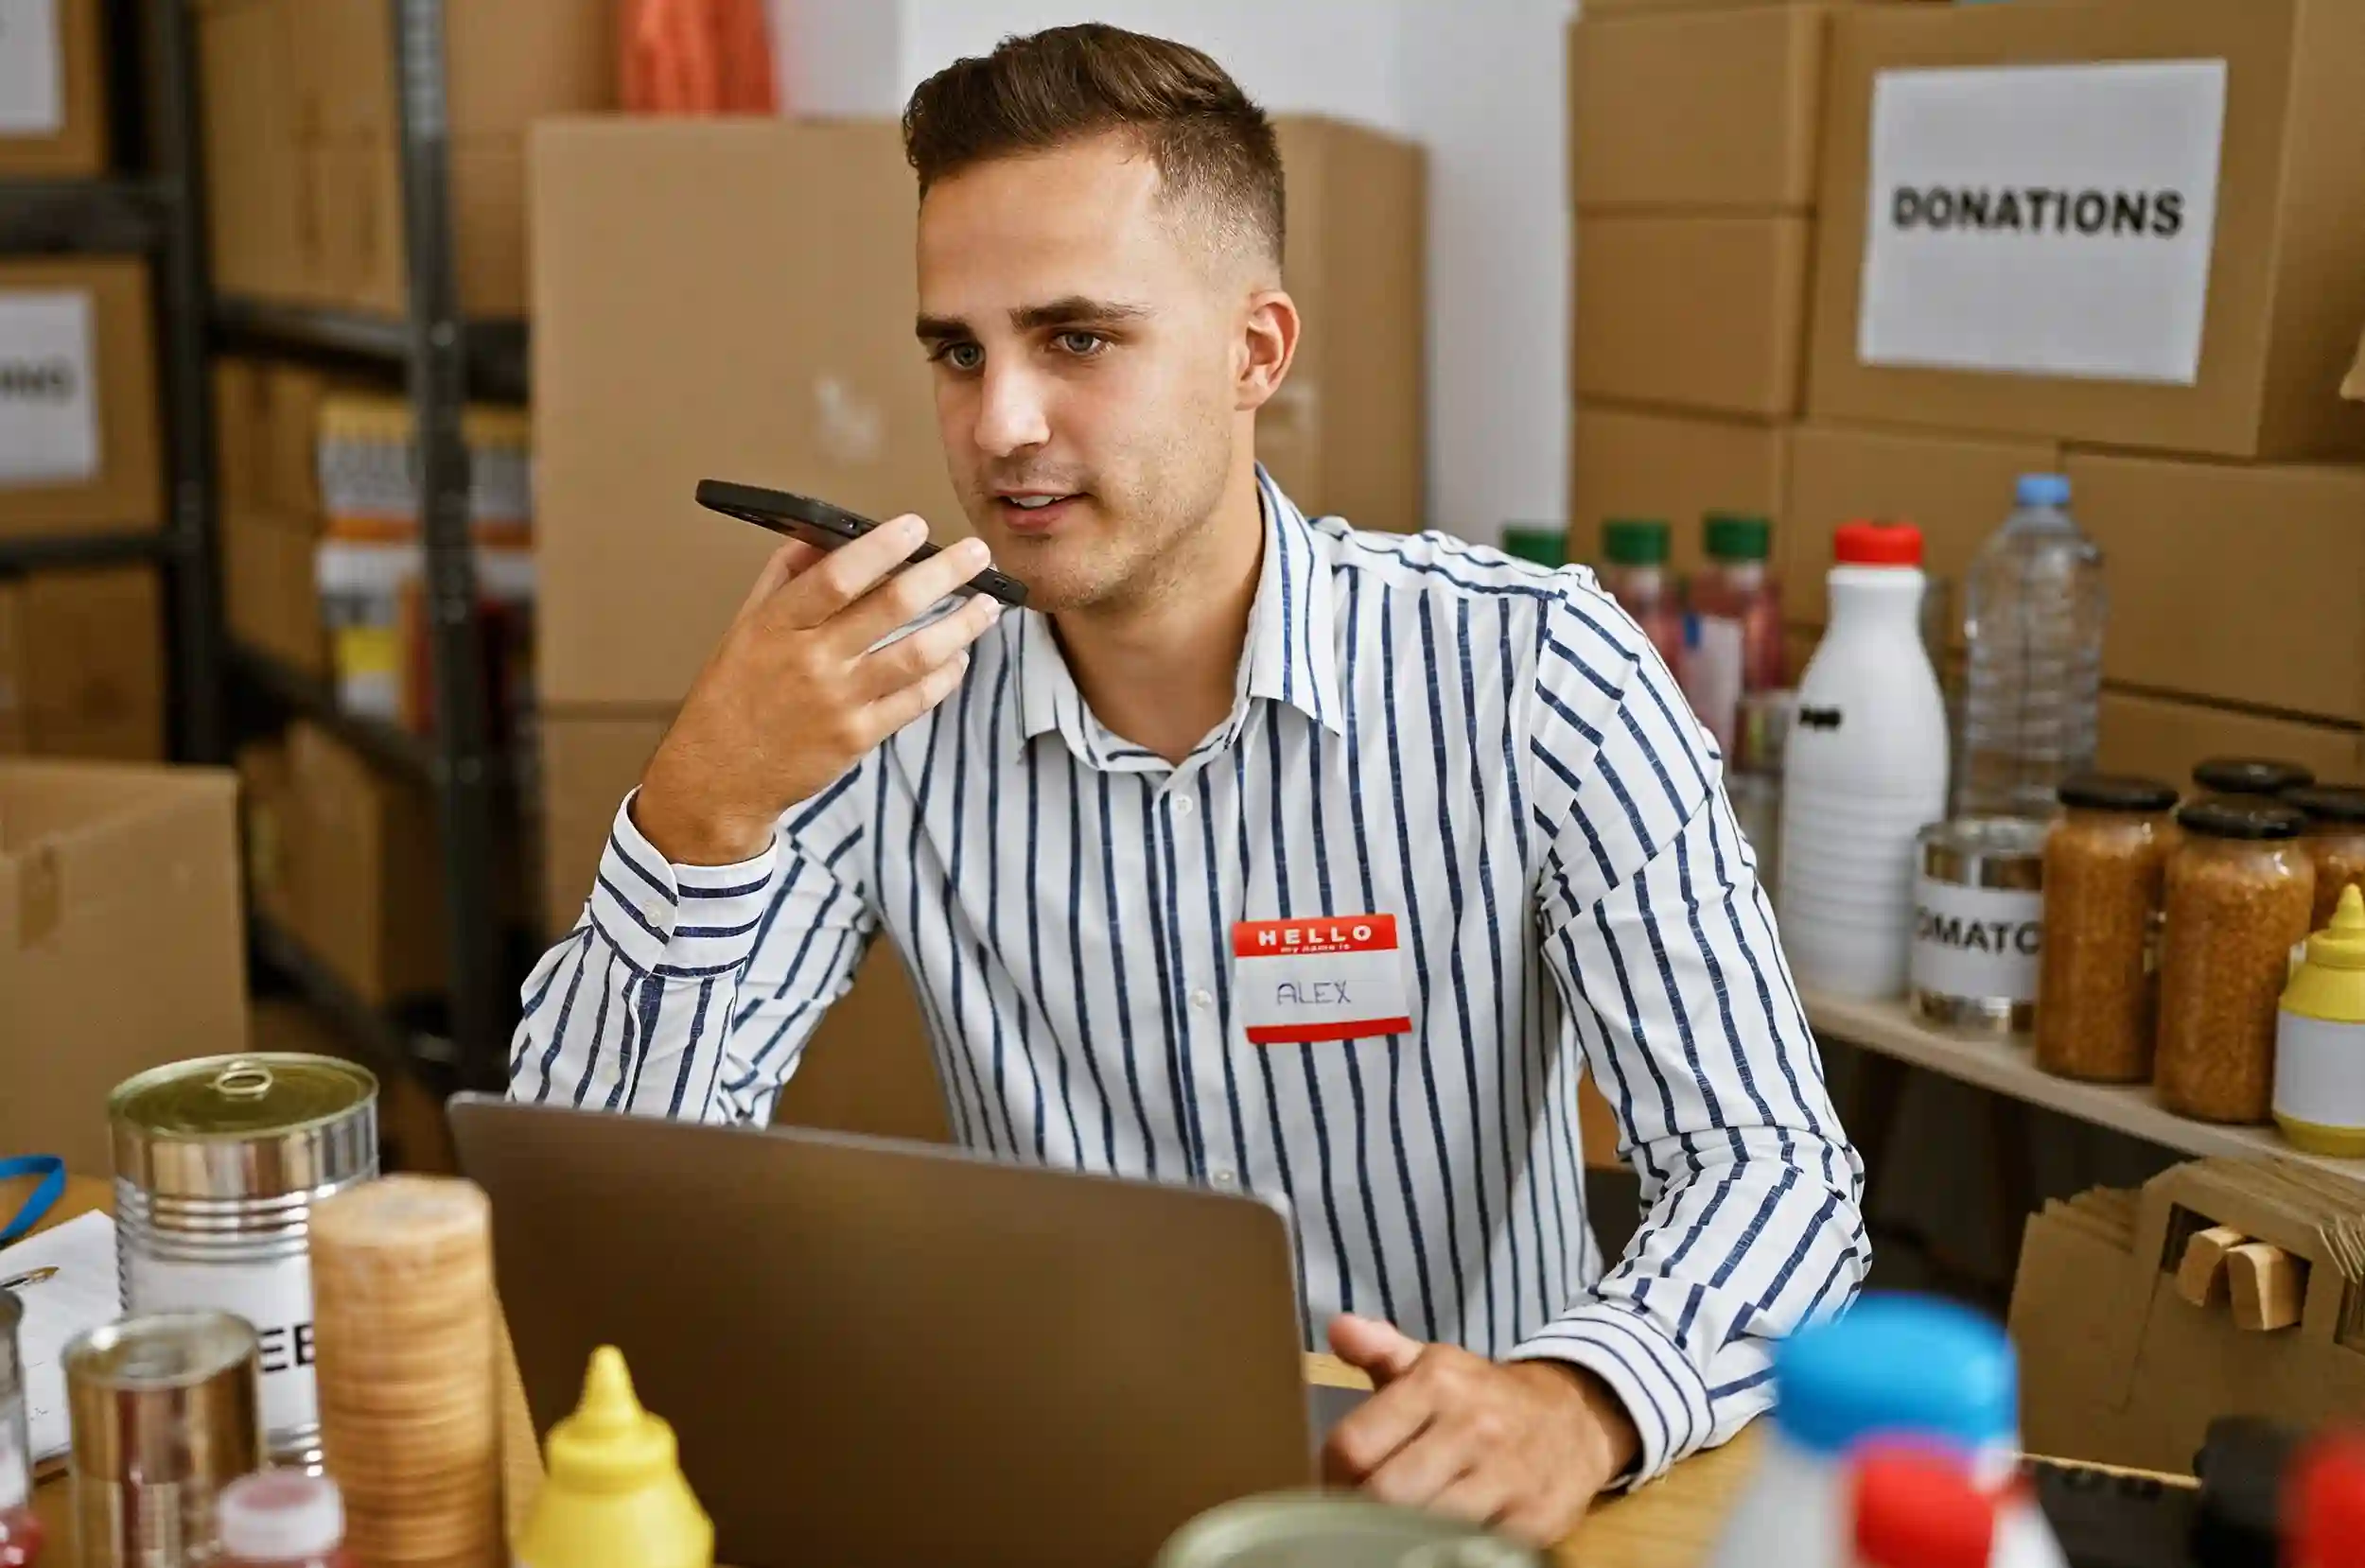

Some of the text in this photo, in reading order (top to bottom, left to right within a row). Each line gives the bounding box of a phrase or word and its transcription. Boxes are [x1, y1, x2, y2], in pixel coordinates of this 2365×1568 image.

[1893, 186, 2184, 239] DONATIONS
[1258, 925, 1372, 947] HELLO
[1302, 943, 1336, 953] name
[1339, 942, 1351, 950] is
[1276, 980, 1351, 1005] ALEX
